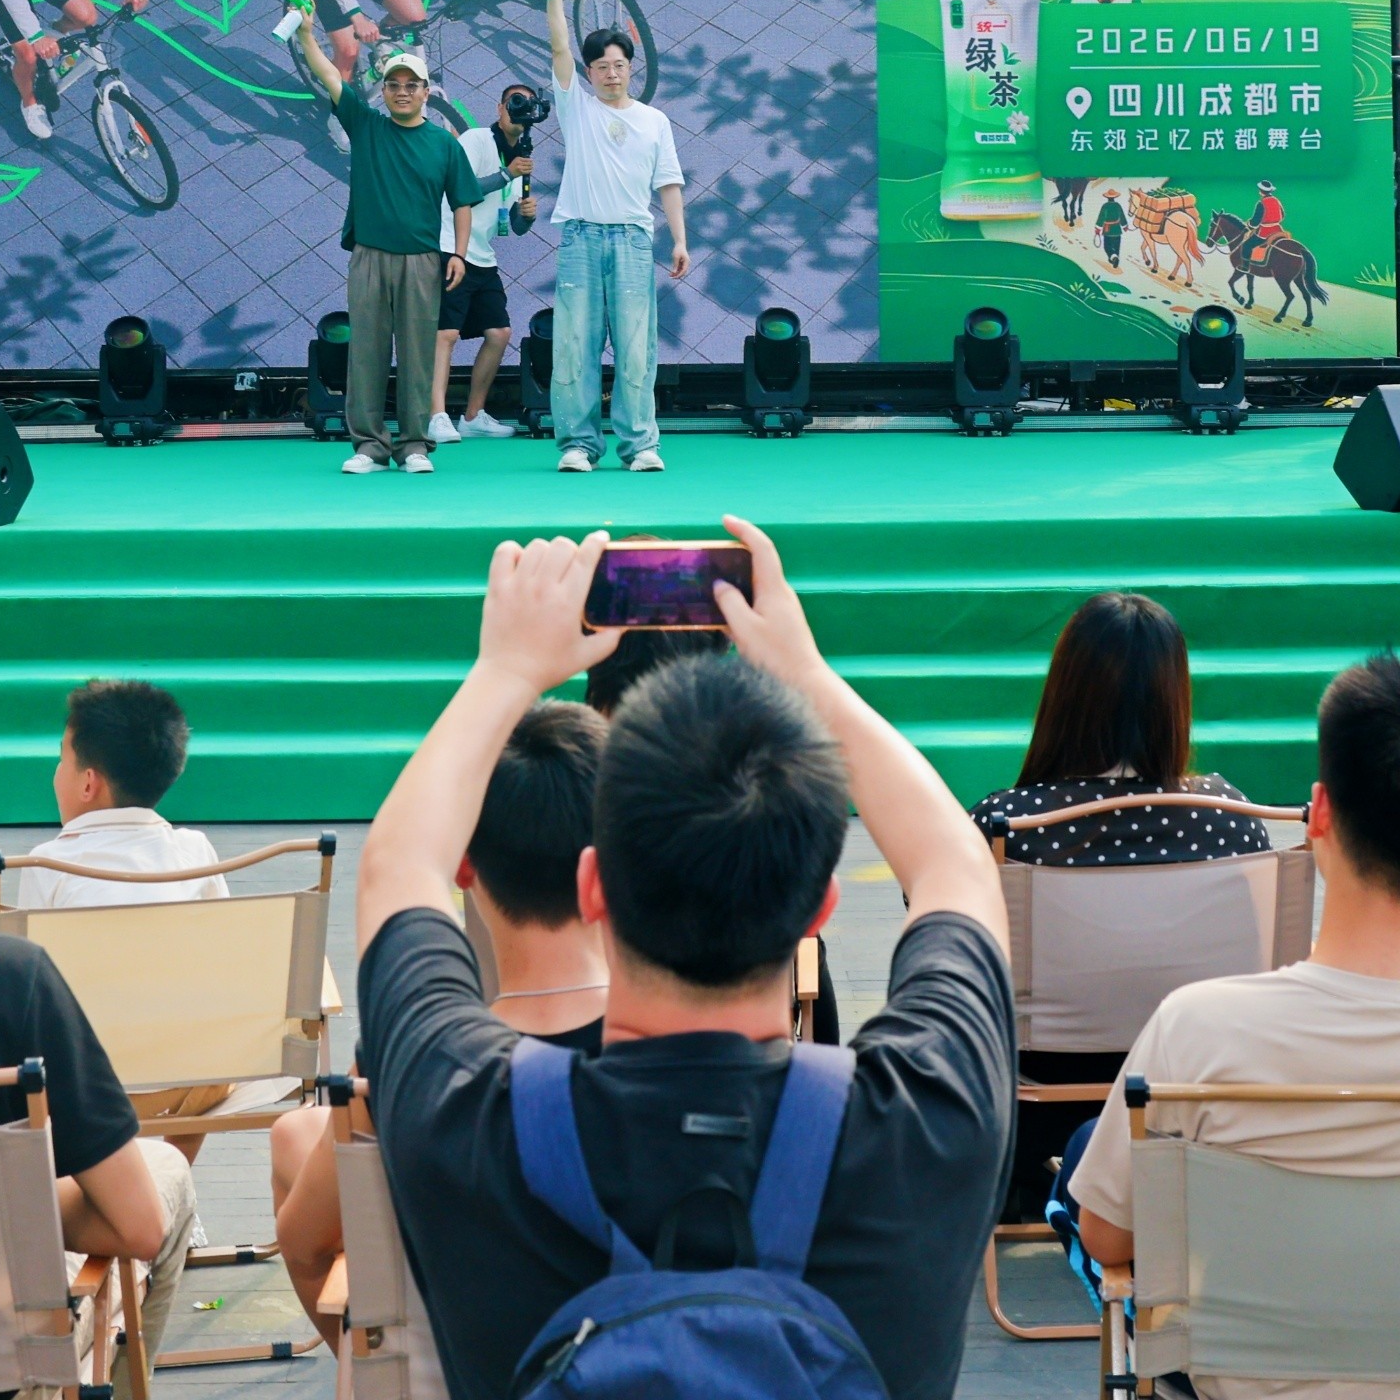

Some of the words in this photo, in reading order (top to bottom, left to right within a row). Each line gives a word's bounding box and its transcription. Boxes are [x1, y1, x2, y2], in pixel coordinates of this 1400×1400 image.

[1076, 27, 1320, 55] 2026/06/19
[965, 37, 1020, 108] 绿茶
[1108, 82, 1323, 118] 四川成都市
[1070, 128, 1323, 152] 东郊记忆成都舞台
